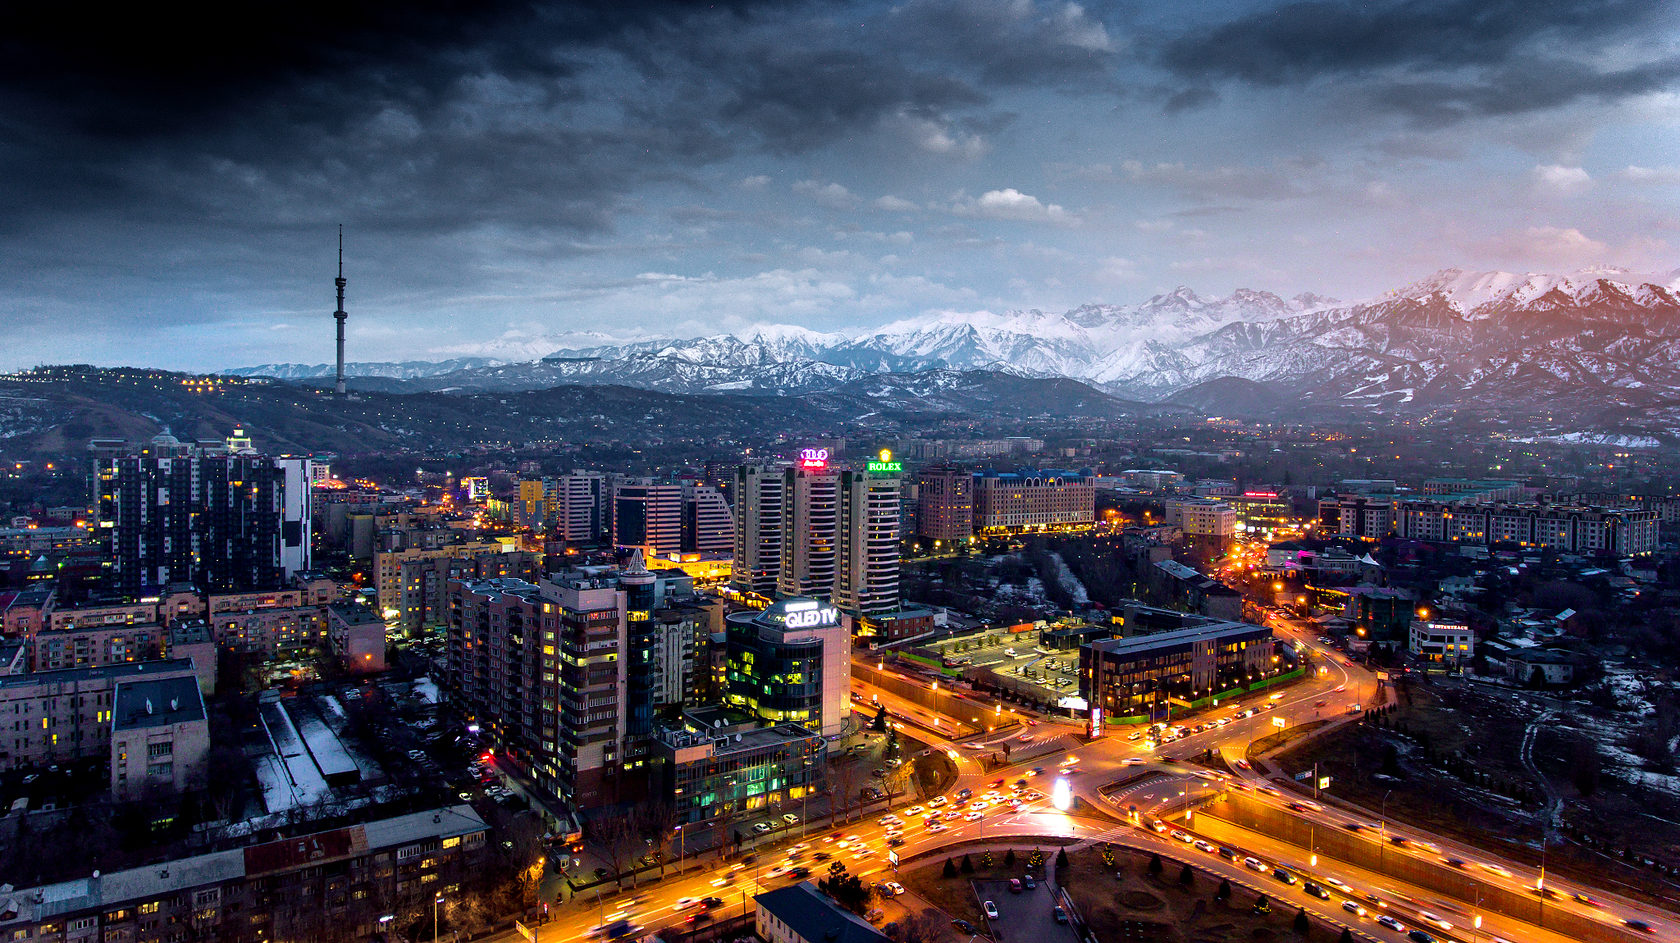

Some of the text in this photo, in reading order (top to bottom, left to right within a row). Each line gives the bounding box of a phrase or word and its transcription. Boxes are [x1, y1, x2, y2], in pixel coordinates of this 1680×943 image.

[868, 462, 902, 471] ROLEX
[786, 608, 837, 628] QLED TV
